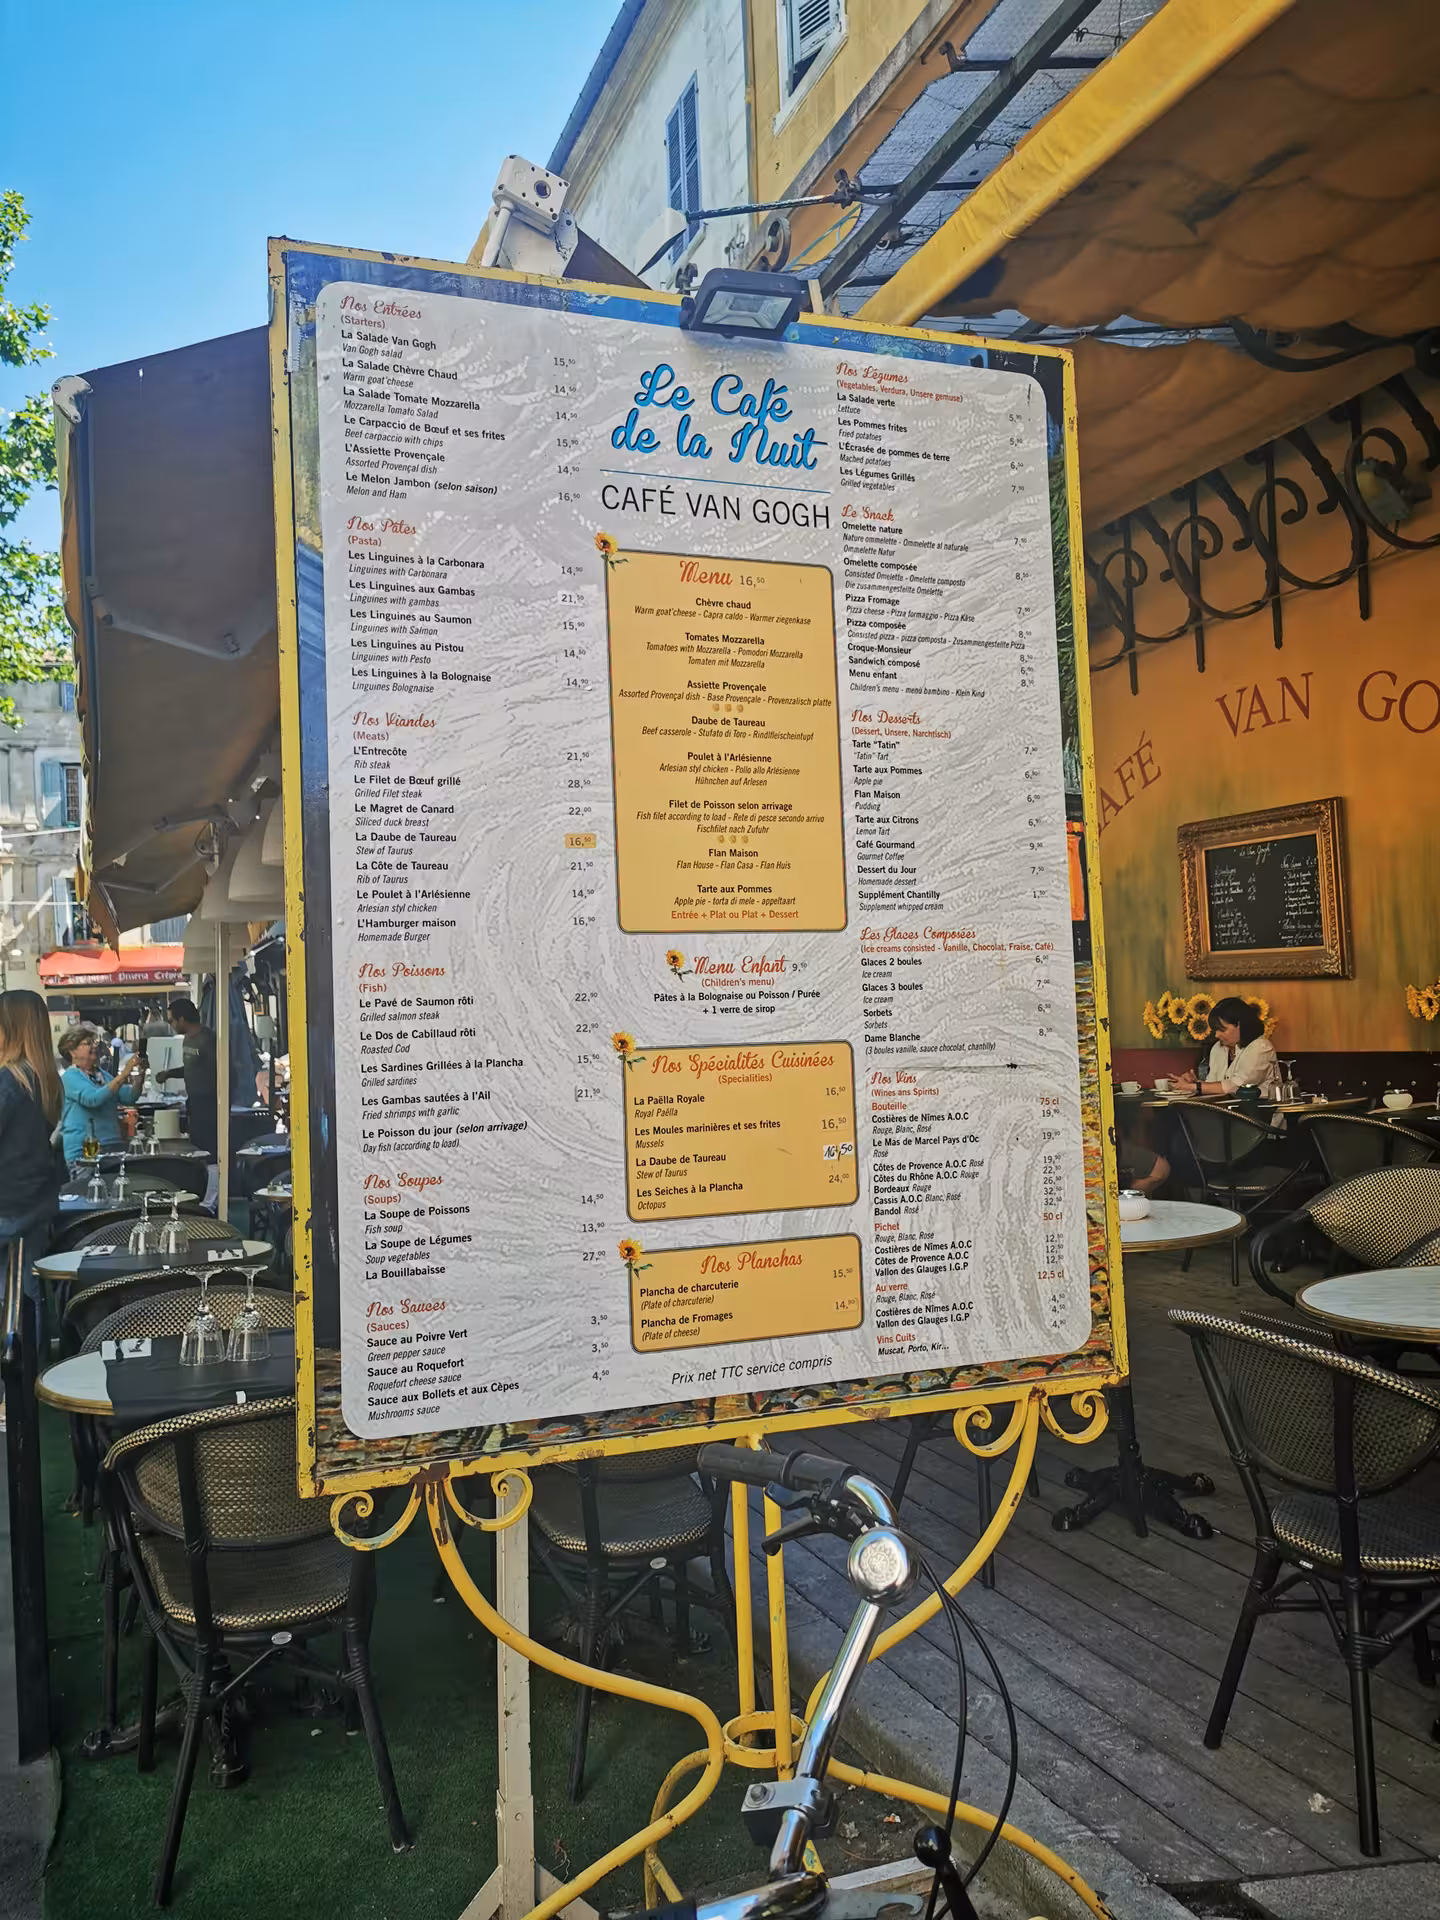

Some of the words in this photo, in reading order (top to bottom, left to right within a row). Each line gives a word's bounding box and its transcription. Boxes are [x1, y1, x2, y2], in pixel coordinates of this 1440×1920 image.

[339, 295, 367, 312] Nos
[373, 300, 422, 319] Entrées
[340, 314, 385, 329] (Starters)
[341, 329, 353, 339] La
[356, 331, 389, 344] Salade
[391, 335, 409, 346] Van
[411, 338, 436, 351] Gogh
[342, 342, 357, 353] Van
[358, 344, 379, 357] Gogh
[380, 349, 403, 359] salad
[341, 357, 353, 368] La
[357, 359, 390, 372] Salade
[392, 364, 425, 376] Chèvre
[427, 368, 458, 380] Chaud
[835, 362, 858, 377] Nos
[862, 365, 908, 384] Légumes
[634, 363, 695, 411] Le
[711, 374, 793, 426] Café
[836, 392, 847, 401] La
[848, 393, 874, 405] Salade
[876, 398, 895, 407] verte
[611, 408, 662, 454] de
[676, 414, 713, 461] la
[729, 422, 829, 471] Nuit
[345, 443, 391, 456] L'Assiette
[394, 448, 445, 463] Provençale
[601, 484, 676, 515] CAFÉ
[685, 492, 740, 521] VAN
[752, 498, 830, 529] GOGH
[840, 503, 857, 518] Le
[861, 505, 894, 522] Snack
[346, 515, 375, 531] Nos
[380, 518, 416, 535] Pâtes
[347, 534, 382, 547] (Pasta)
[348, 549, 365, 560] Les
[368, 551, 415, 564] Linguines
[417, 555, 423, 564] à
[426, 556, 435, 565] la
[437, 556, 485, 569] Carbonara
[679, 560, 733, 585] Menu
[695, 597, 724, 607] Chèvre
[725, 599, 751, 609] chaud
[845, 593, 866, 603] Pizza
[867, 595, 900, 607] Fromage
[684, 632, 719, 643] Tomates
[721, 634, 765, 645] Mozzarella
[847, 642, 912, 655] Croque-Monsieur
[1215, 672, 1314, 738] VAN
[351, 710, 379, 726] Nos
[385, 711, 436, 728] Viandes
[691, 715, 718, 725] Daube
[720, 717, 731, 726] de
[732, 717, 765, 727] Taureau
[851, 709, 872, 723] Nos
[876, 709, 921, 724] Desserts
[352, 730, 389, 741] (Meats)
[353, 745, 407, 756] L'Entrecôte
[353, 759, 367, 769] Rib
[369, 760, 391, 769] steak
[353, 774, 366, 784] Le
[369, 774, 391, 784] Filet
[393, 775, 406, 784] de
[408, 775, 434, 785] Bœuf
[437, 776, 461, 787] grillé
[1098, 730, 1162, 838] AFÉ
[354, 803, 366, 812] Le
[369, 803, 403, 815] Magret
[405, 804, 418, 813] de
[420, 804, 454, 814] Canard
[668, 799, 688, 808] Filet
[690, 800, 701, 808] de
[703, 800, 735, 809] Poisson
[737, 801, 759, 810] selon
[761, 801, 793, 812] arrivage
[855, 839, 874, 848] Café
[875, 840, 915, 849] Gourmand
[696, 884, 718, 893] Tarte
[737, 884, 773, 893] Pommes
[357, 918, 419, 929] L'Hamburger
[422, 917, 456, 927] maison
[860, 927, 882, 941] Les
[883, 926, 920, 942] Glaces
[923, 927, 977, 949] Composées
[692, 956, 737, 976] Menu
[741, 954, 789, 977] Enfant
[860, 957, 887, 967] Glaces
[889, 957, 895, 966] 2
[896, 957, 922, 966] boules
[357, 962, 386, 978] Nos
[391, 962, 446, 977] Poissons
[358, 983, 387, 993] (Fish)
[359, 998, 371, 1008] Le
[374, 997, 397, 1007] Pavé
[400, 998, 413, 1007] de
[415, 997, 455, 1006] Saumon
[458, 995, 474, 1005] rôti
[361, 1063, 378, 1073] Les
[380, 1062, 423, 1072] Sardines
[426, 1060, 462, 1070] Grillées
[465, 1059, 471, 1069] à
[474, 1059, 483, 1068] la
[485, 1057, 523, 1068] Plancha
[650, 1055, 682, 1074] Nos
[688, 1052, 766, 1074] Spécialités
[771, 1050, 836, 1069] Cuisinées
[870, 1071, 892, 1085] Nos
[895, 1070, 917, 1084] Vins
[633, 1096, 644, 1106] La
[647, 1095, 674, 1105] Paëlla
[676, 1093, 705, 1105] Royale
[871, 1101, 907, 1111] Bouteille
[362, 1174, 392, 1191] Nos
[396, 1171, 444, 1195] Soupes
[363, 1193, 401, 1205] (Soups)
[874, 1221, 900, 1232] Pichet
[700, 1254, 731, 1275] Nos
[737, 1247, 802, 1271] Planchas
[365, 1270, 377, 1280] La
[381, 1265, 445, 1279] Bouillabaisse
[365, 1301, 394, 1318] Nos
[399, 1298, 446, 1314] Sauces
[366, 1319, 410, 1333] (Sauces)
[366, 1337, 397, 1348] Sauce
[400, 1336, 413, 1344] au
[416, 1331, 446, 1343] Poivre
[448, 1328, 468, 1339] Vert
[876, 1335, 894, 1344] Vins
[895, 1332, 916, 1342] Cuits
[671, 1372, 695, 1385] Prix
[697, 1368, 717, 1382] net
[720, 1364, 743, 1378] TTC
[746, 1361, 785, 1376] service
[788, 1354, 832, 1371] compris
